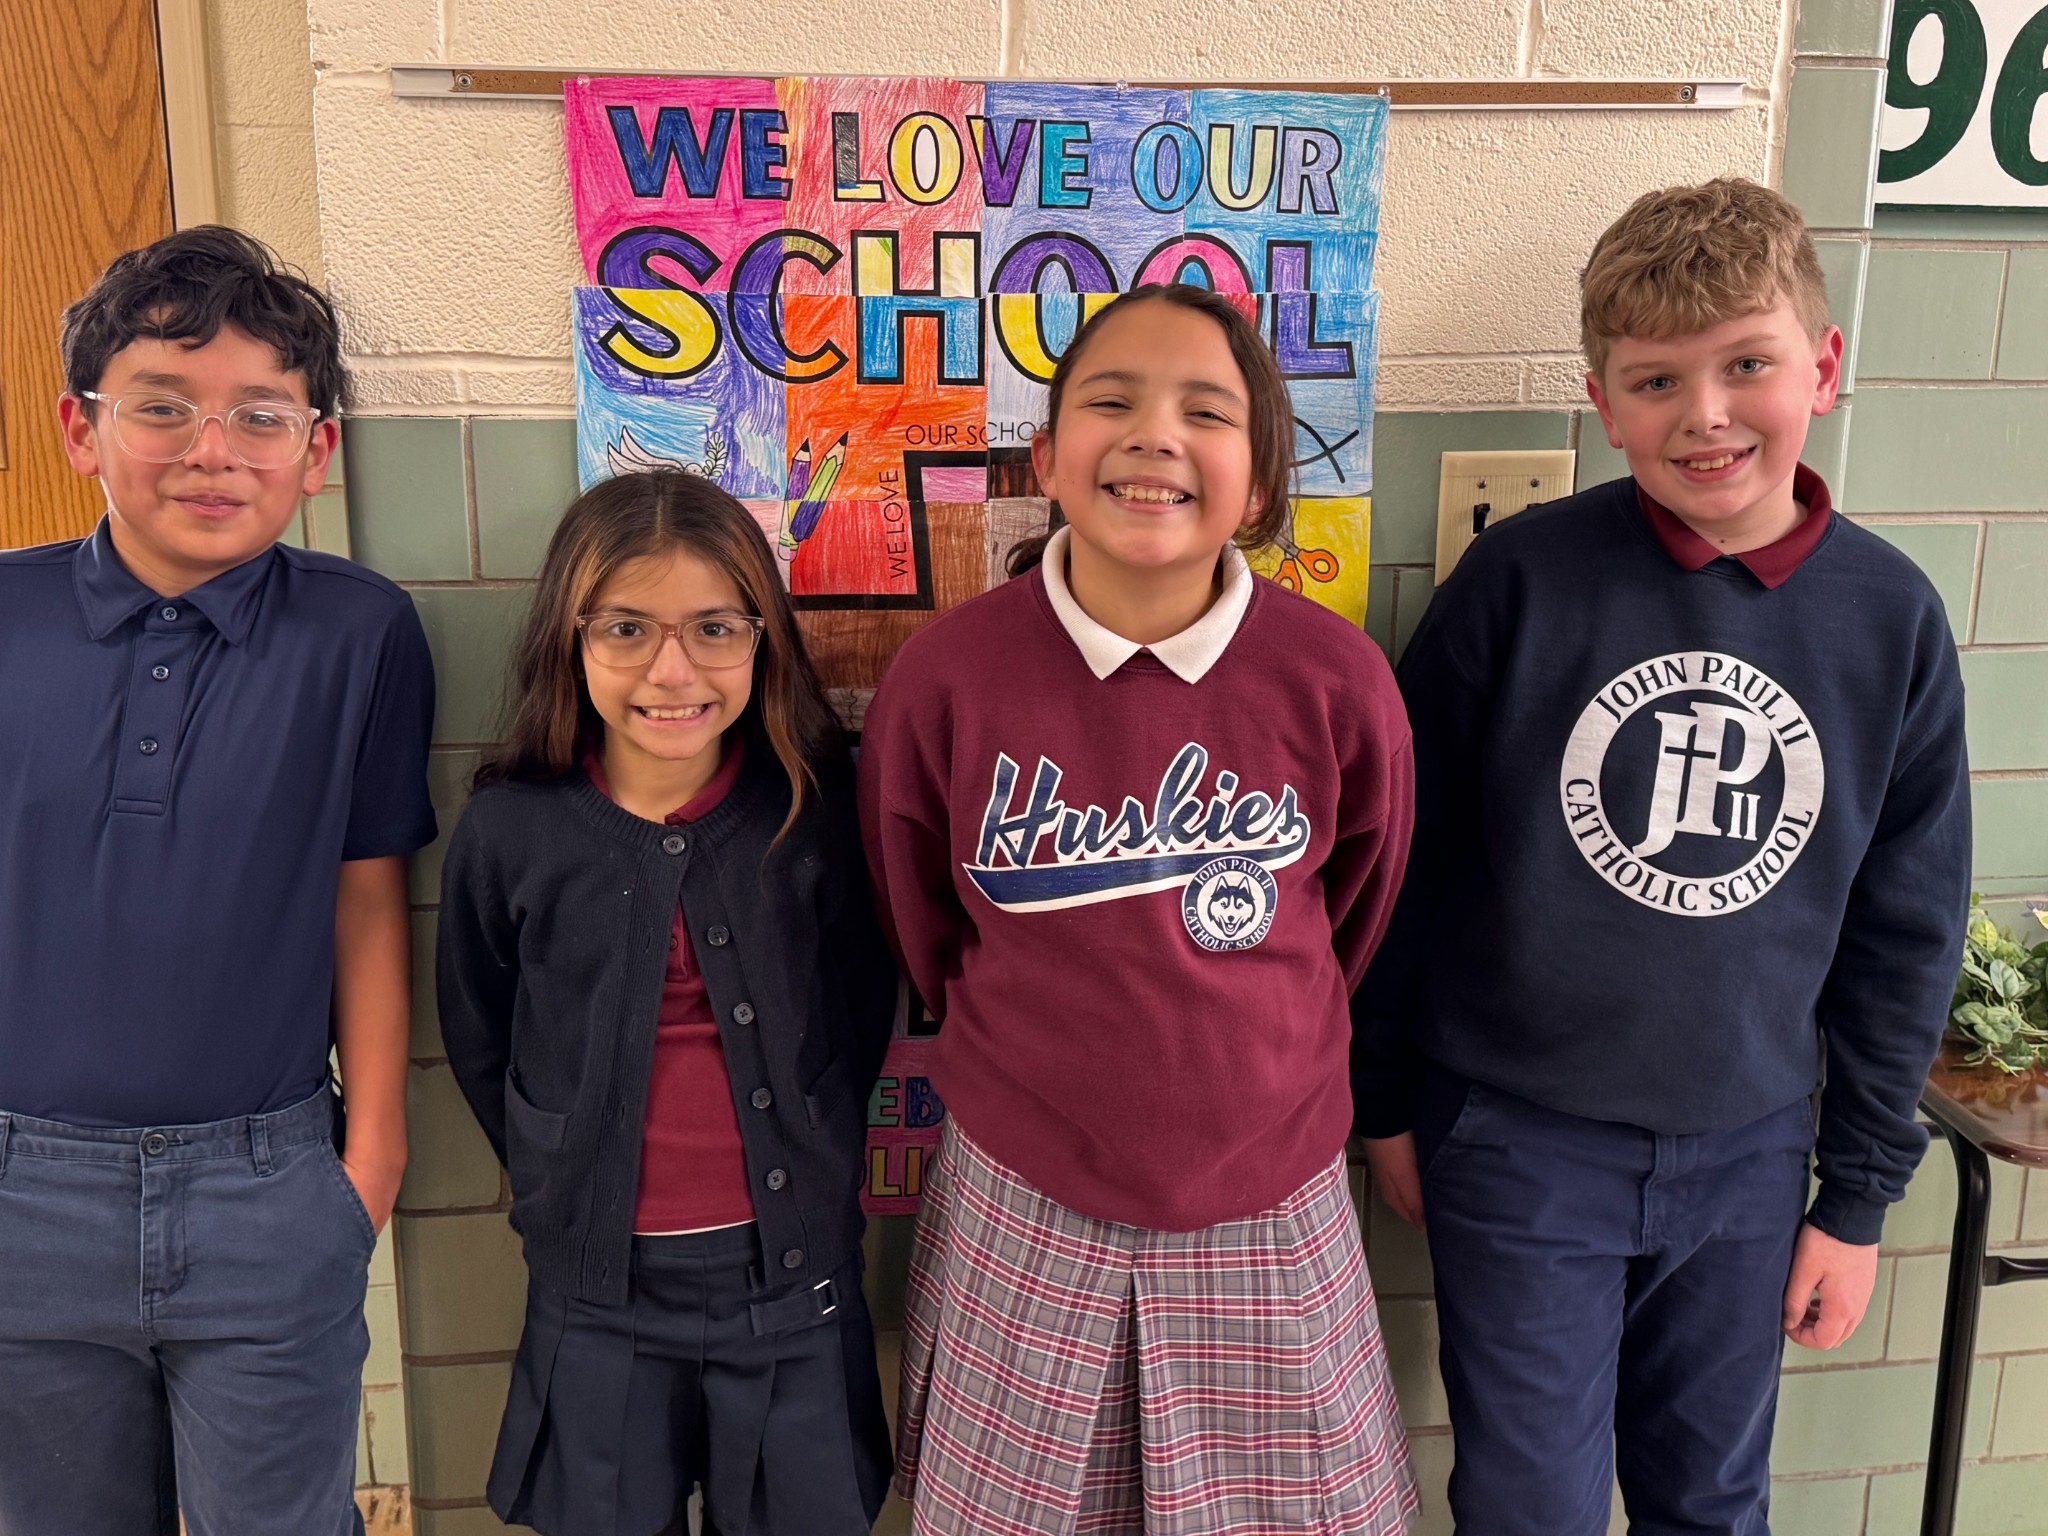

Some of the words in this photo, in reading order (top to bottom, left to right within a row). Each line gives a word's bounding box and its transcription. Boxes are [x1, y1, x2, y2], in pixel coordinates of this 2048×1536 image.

[605, 105, 793, 201] WE
[832, 111, 1093, 209] LOVE
[1131, 121, 1342, 216] OUR
[906, 424, 958, 446] OUR
[966, 421, 1050, 446] SCHO
[879, 470, 905, 534] LOVE
[887, 541, 909, 579] WE
[1594, 657, 1688, 723] JOHN
[1700, 656, 1784, 720] PAUL
[1777, 716, 1811, 748] II
[976, 742, 1308, 868] Huskies
[1194, 860, 1228, 886] JOHN
[1231, 859, 1263, 880] PAUL
[1261, 877, 1273, 889] II
[1566, 778, 1699, 911] CATHOLIC
[1708, 809, 1814, 910] SCHOOL
[1186, 906, 1234, 950] CATHOLIC
[1236, 909, 1274, 949] SCHOOL
